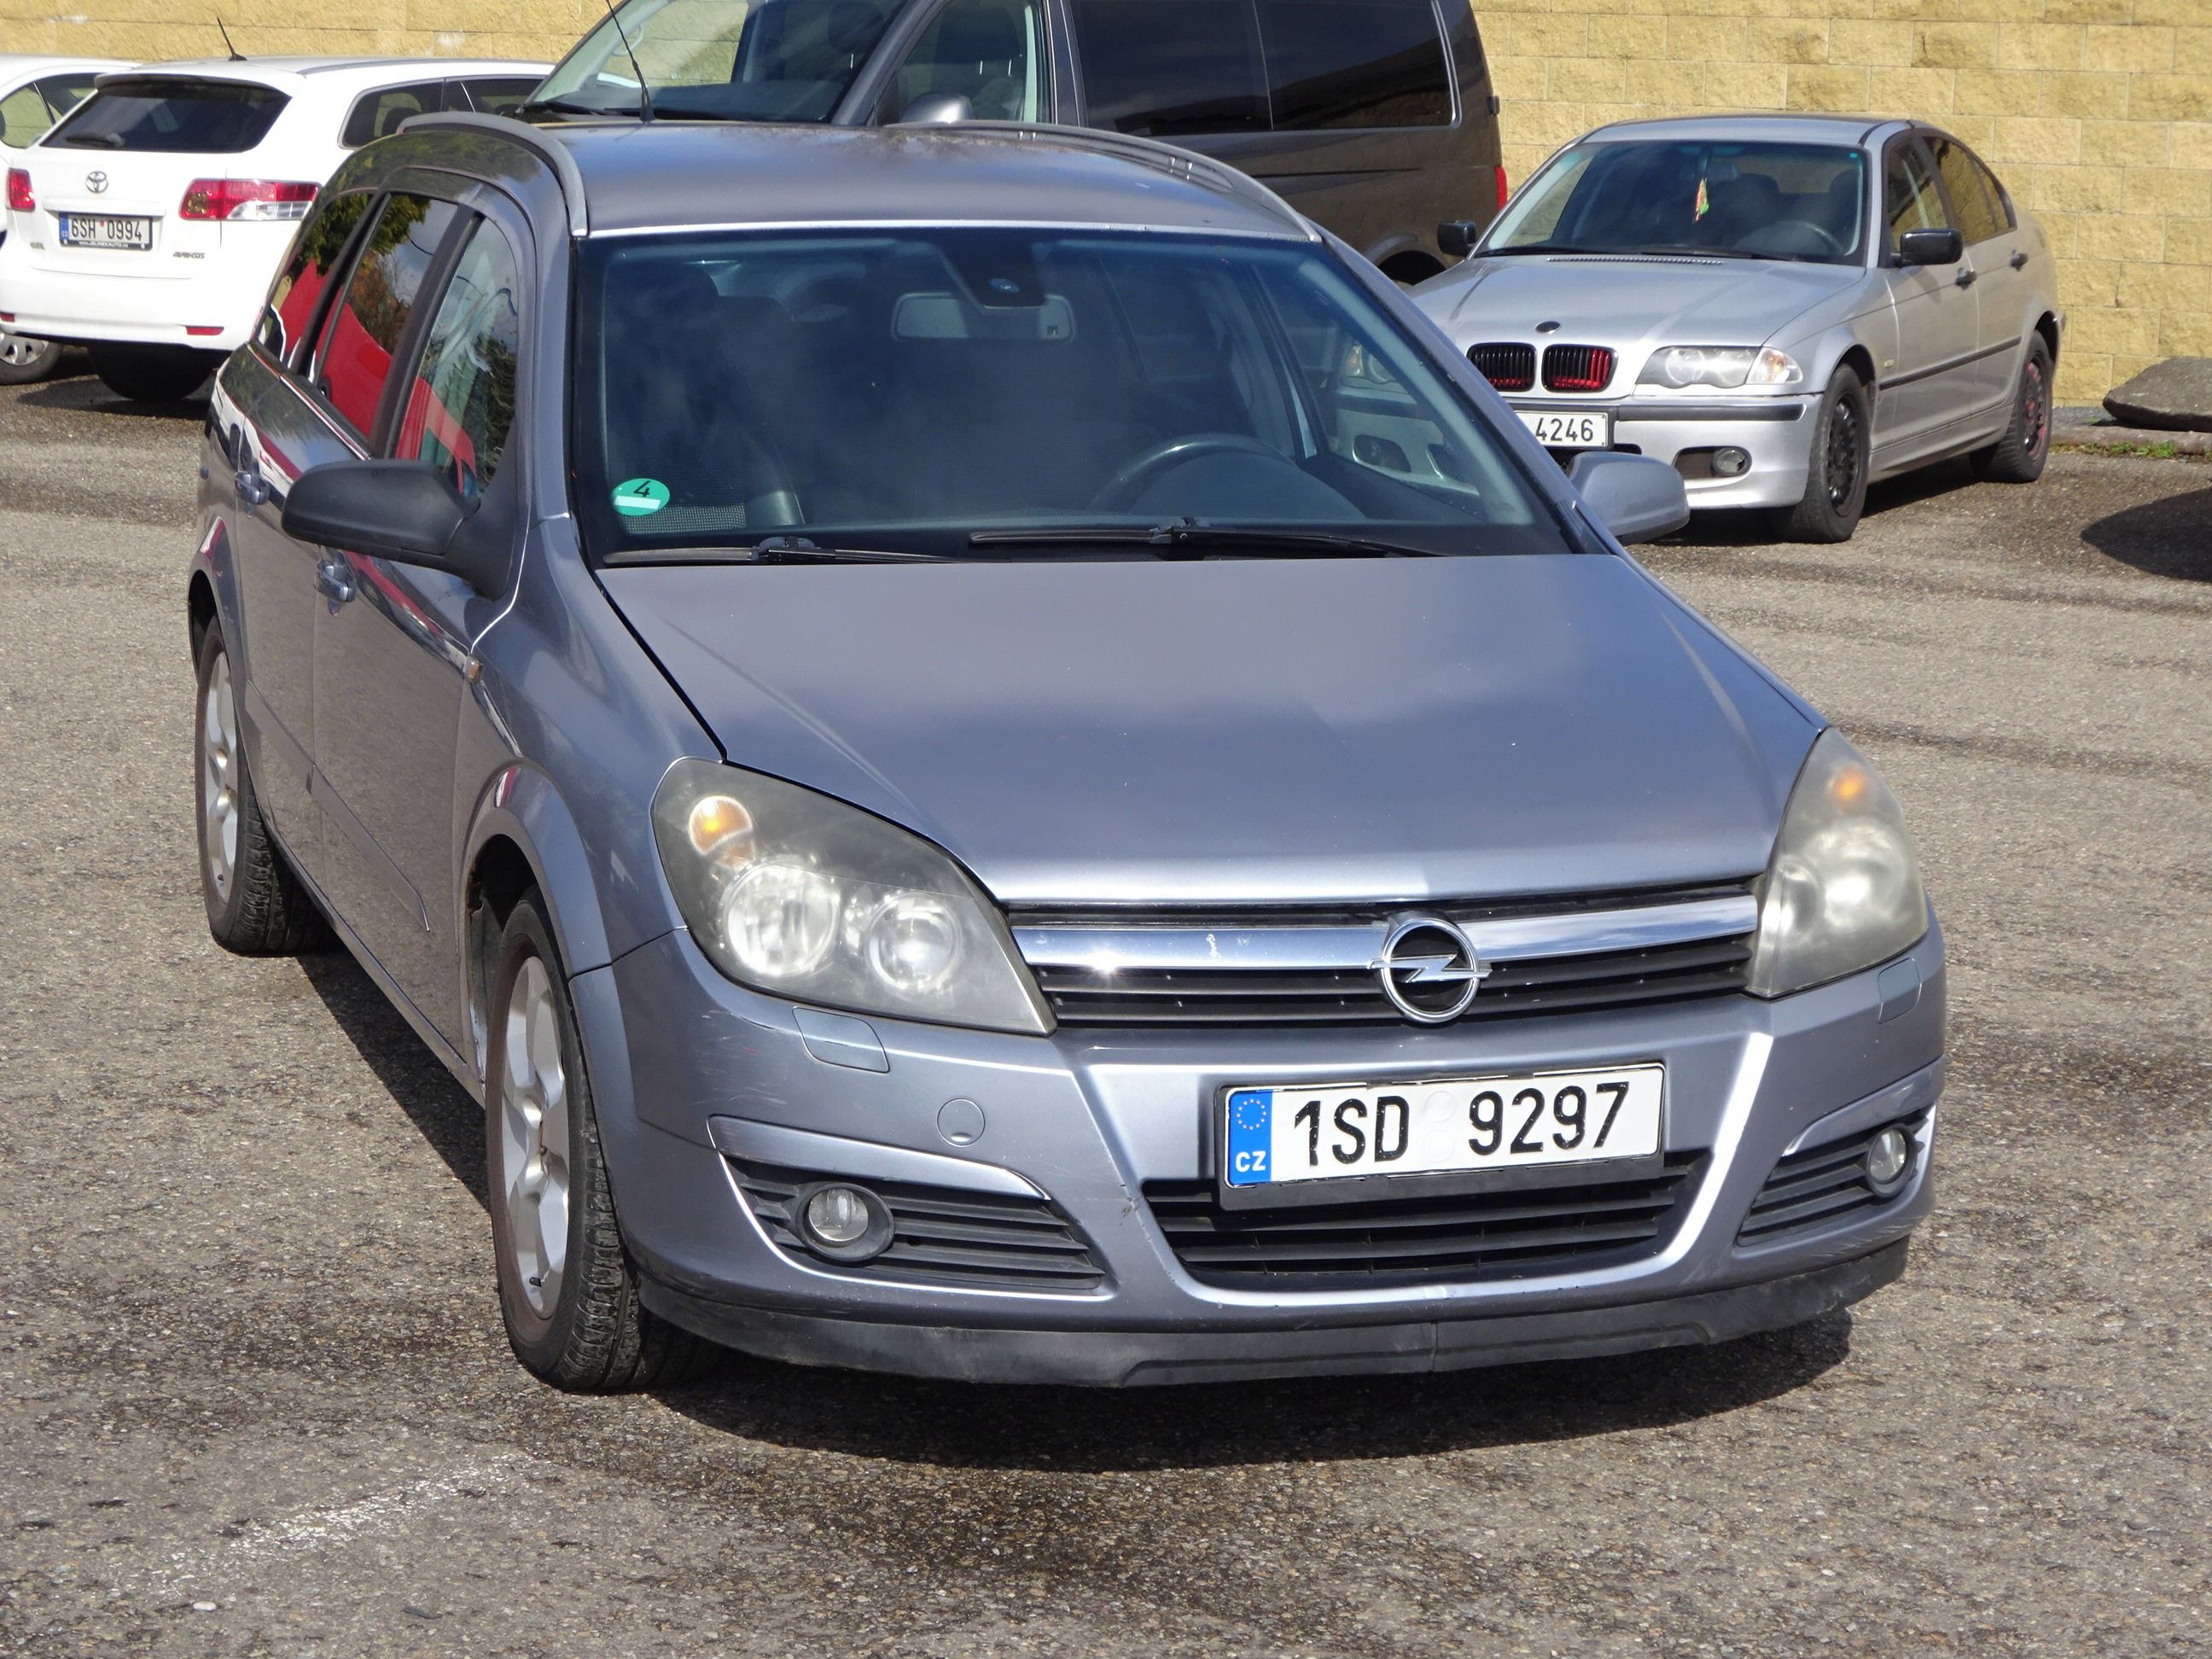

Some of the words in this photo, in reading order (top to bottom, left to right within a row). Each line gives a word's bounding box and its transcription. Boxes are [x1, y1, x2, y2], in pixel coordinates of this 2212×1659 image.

[72, 218, 96, 239] 6SH
[107, 220, 143, 242] 0994
[1535, 417, 1593, 442] 4246
[633, 480, 651, 498] 4
[1294, 1095, 1410, 1167] 1SD
[1469, 1081, 1629, 1156] 9297
[1235, 1151, 1266, 1173] CZ
